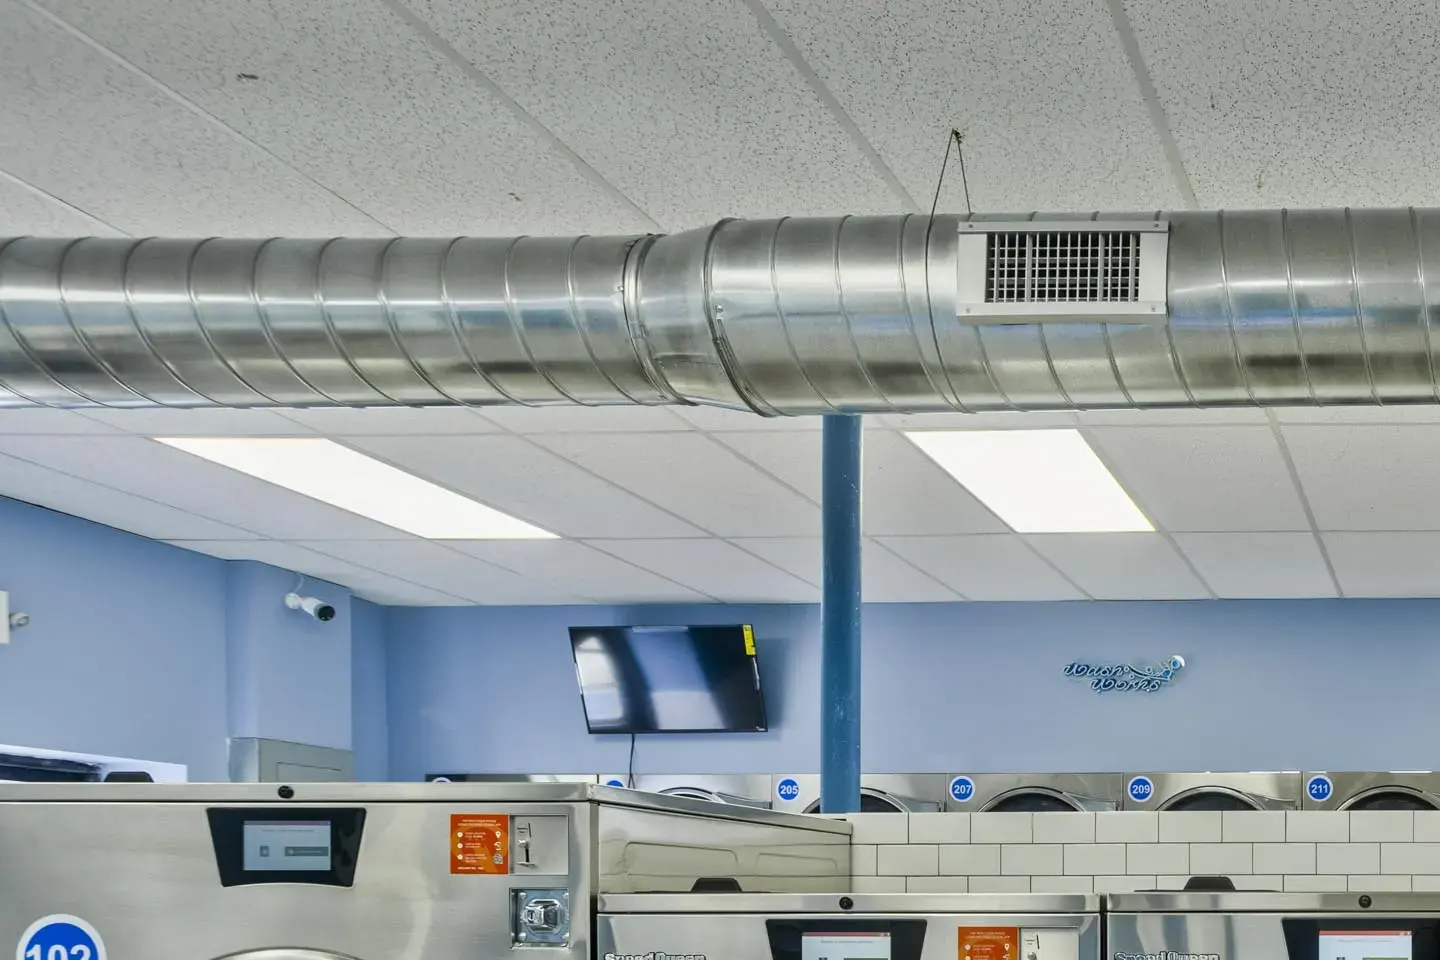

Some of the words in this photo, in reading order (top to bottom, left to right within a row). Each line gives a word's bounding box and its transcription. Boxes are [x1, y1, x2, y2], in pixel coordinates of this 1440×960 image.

[1063, 663, 1125, 677] Wash
[1090, 678, 1161, 692] Works
[780, 785, 799, 795] 205
[953, 784, 972, 794] 207
[1131, 784, 1151, 794] 209
[1311, 784, 1329, 794] 211
